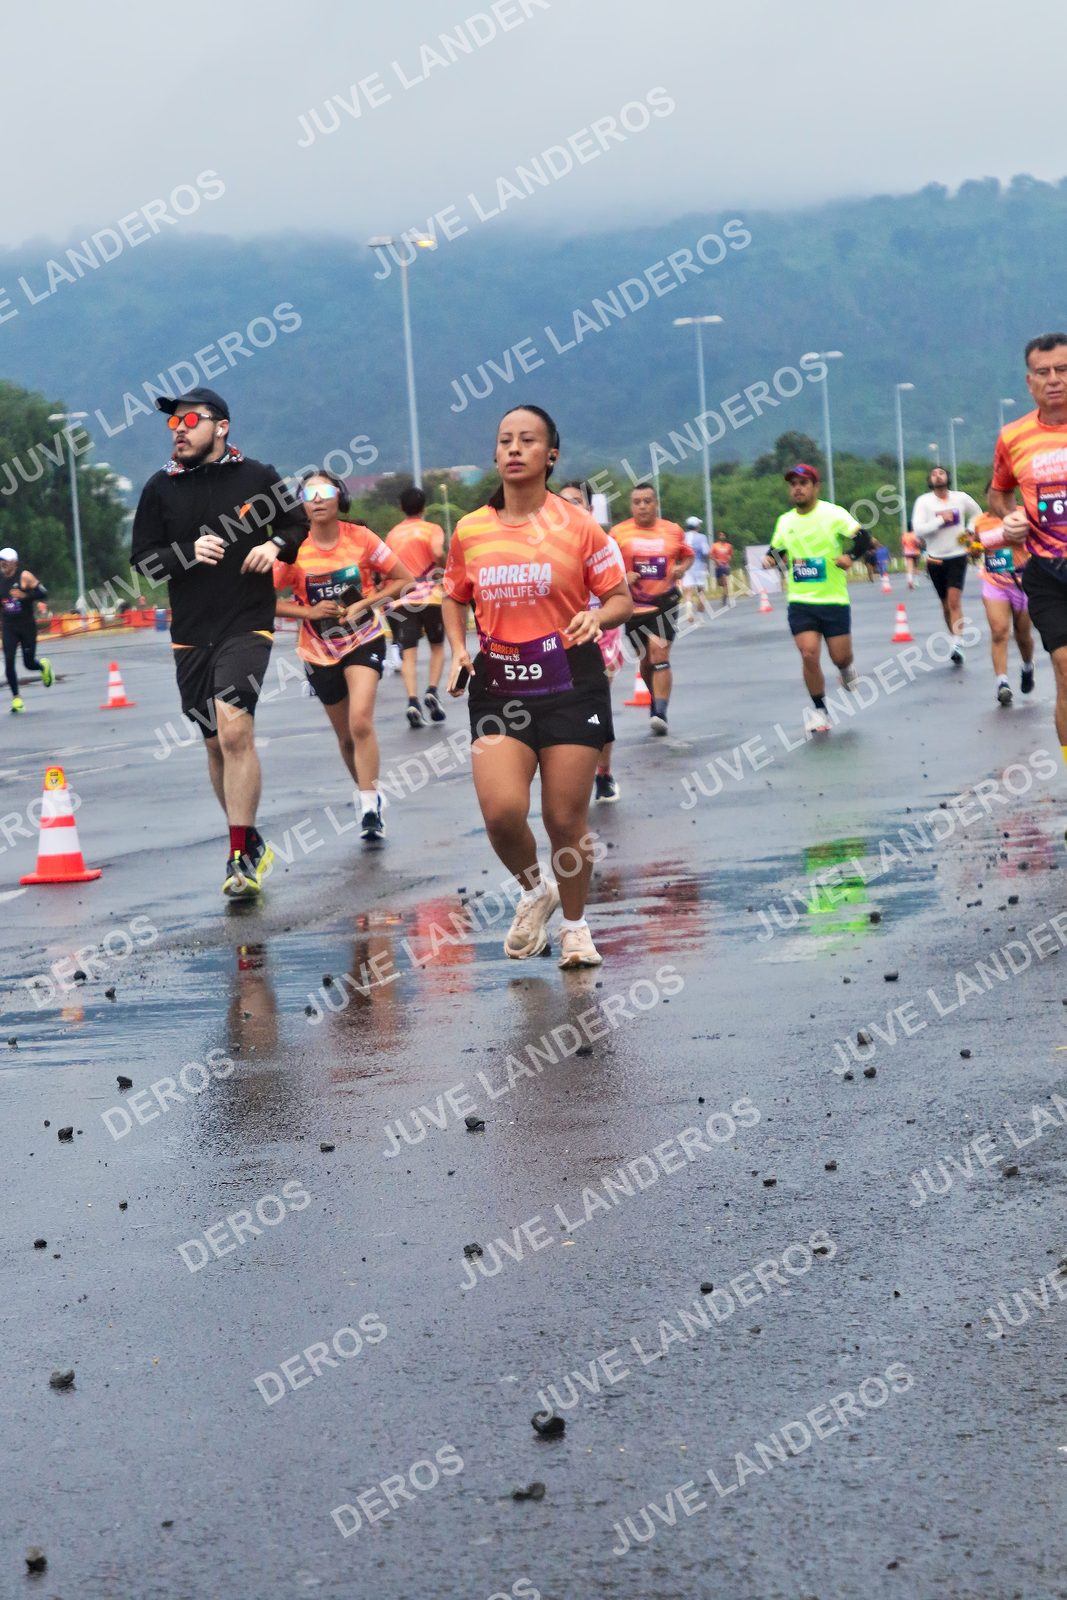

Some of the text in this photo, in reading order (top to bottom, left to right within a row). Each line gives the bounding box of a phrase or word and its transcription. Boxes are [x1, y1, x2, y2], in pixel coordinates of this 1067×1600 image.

[1052, 500, 1067, 515] 6
[480, 563, 552, 586] CARRERA
[481, 585, 535, 601] OMNILIFE
[504, 663, 543, 680] 529
